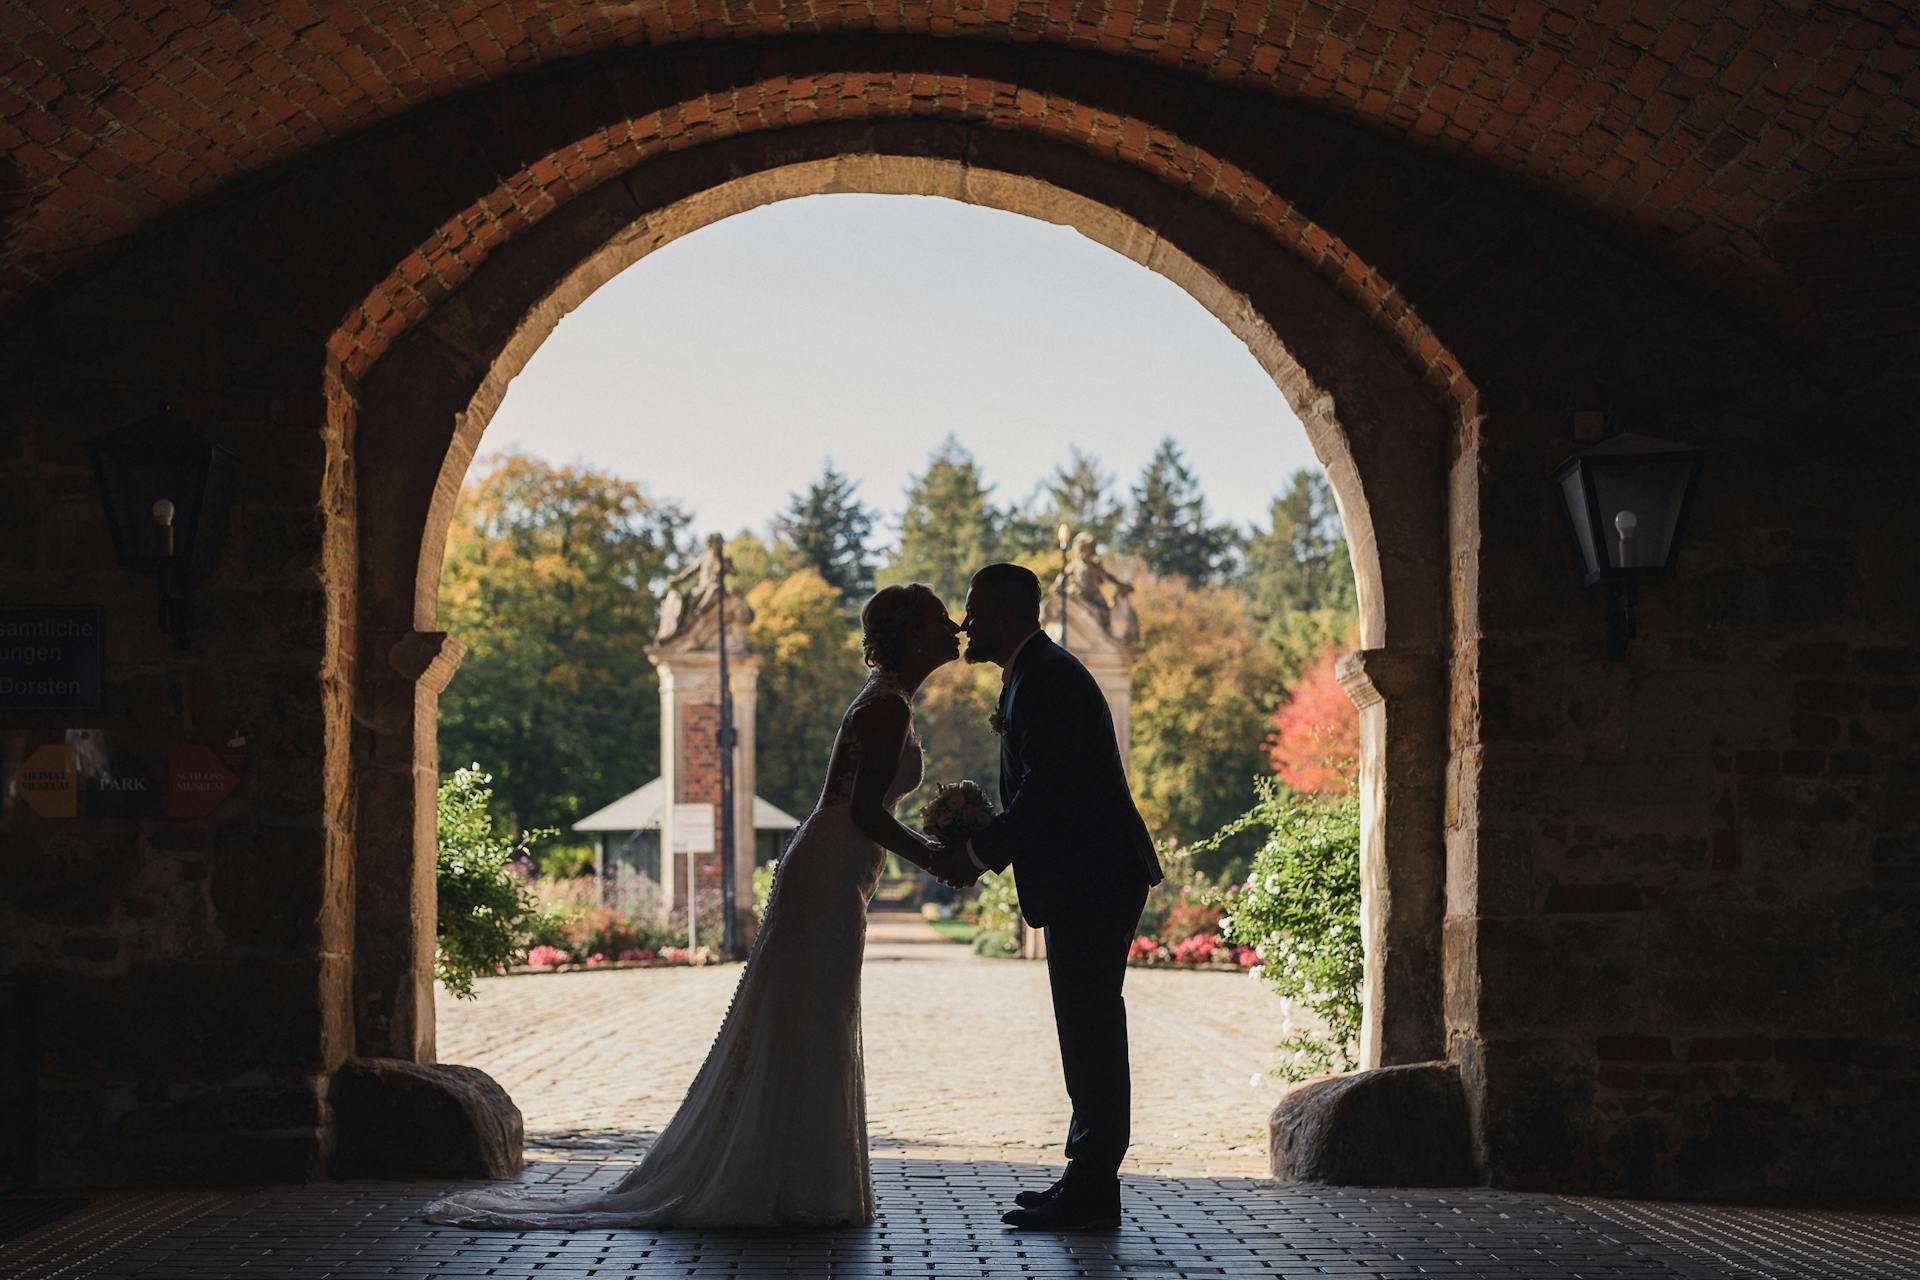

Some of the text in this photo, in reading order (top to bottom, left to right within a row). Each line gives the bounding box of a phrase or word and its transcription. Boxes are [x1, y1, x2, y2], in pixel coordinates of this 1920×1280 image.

[0, 646, 62, 664] ungen
[0, 676, 80, 695] Dorsten
[99, 776, 147, 791] PARK
